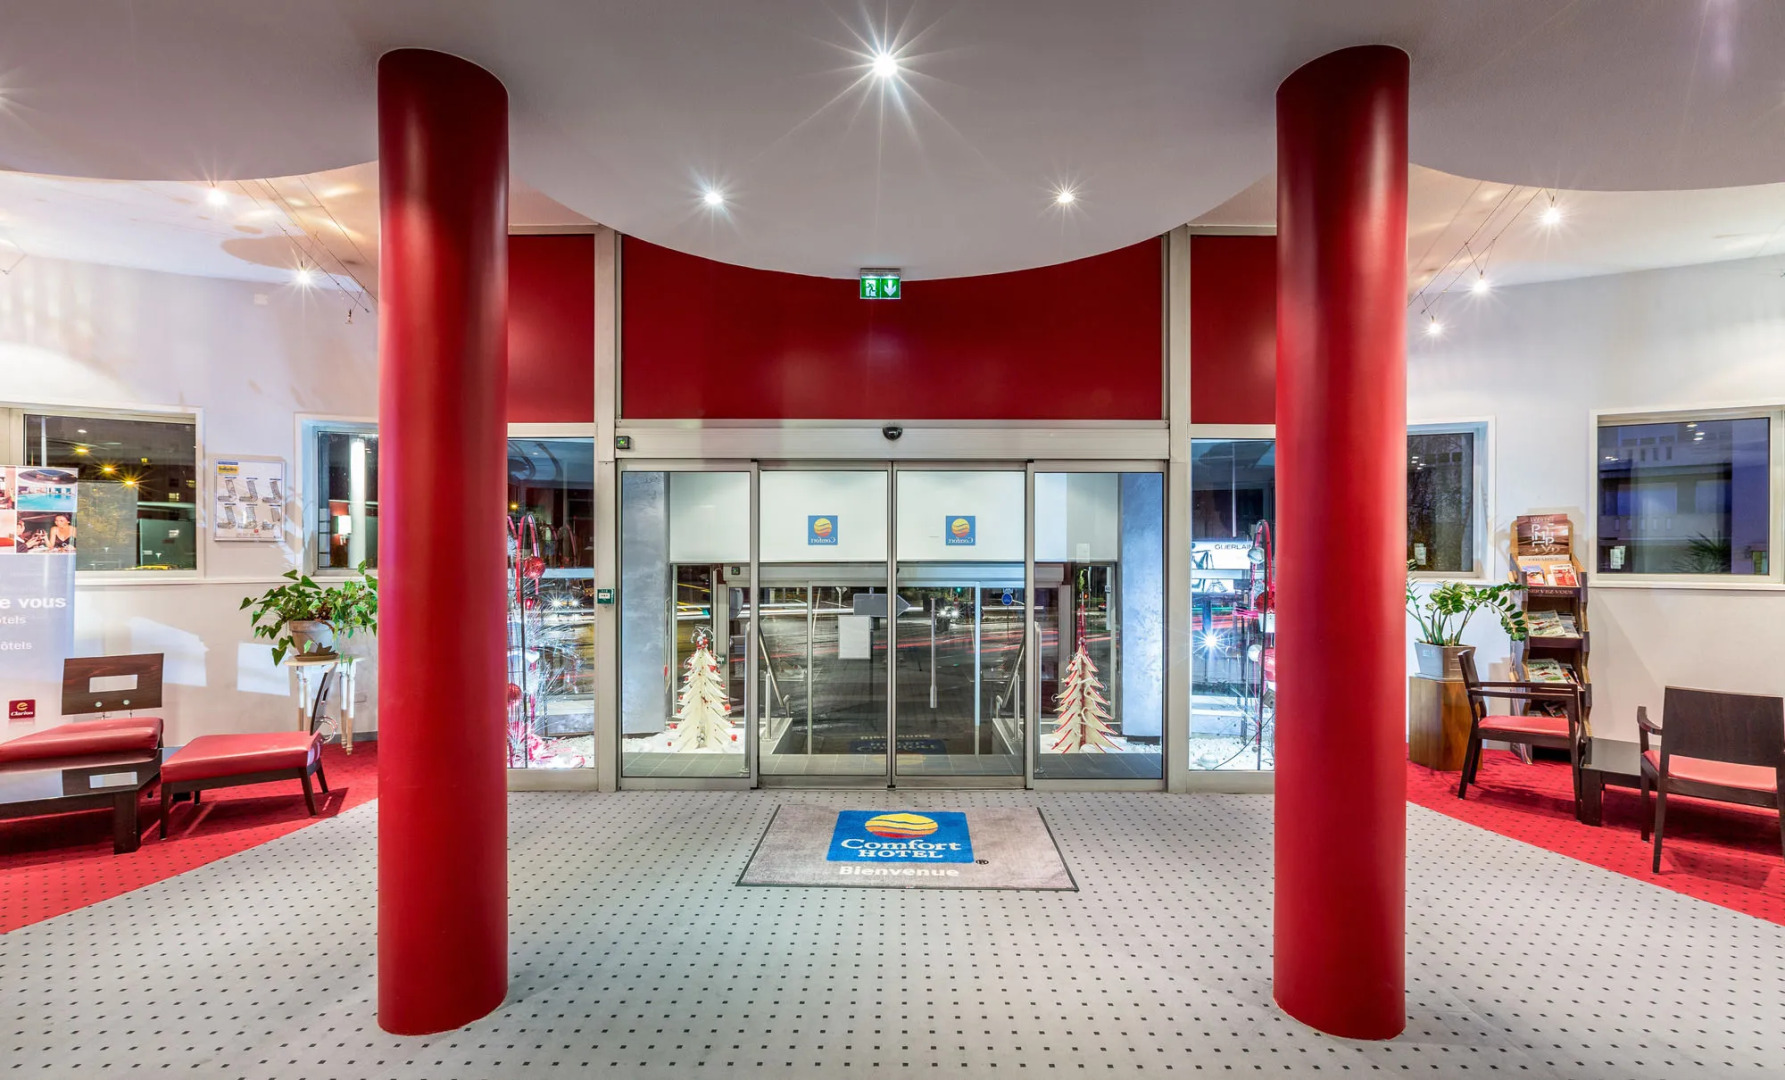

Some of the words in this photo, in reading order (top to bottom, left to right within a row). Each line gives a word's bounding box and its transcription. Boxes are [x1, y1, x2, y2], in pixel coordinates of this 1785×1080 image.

[18, 597, 67, 609] vous
[0, 616, 27, 625] tels
[840, 838, 962, 851] Comfort
[857, 849, 944, 859] HOTEL
[838, 865, 960, 877] Bienvenue
